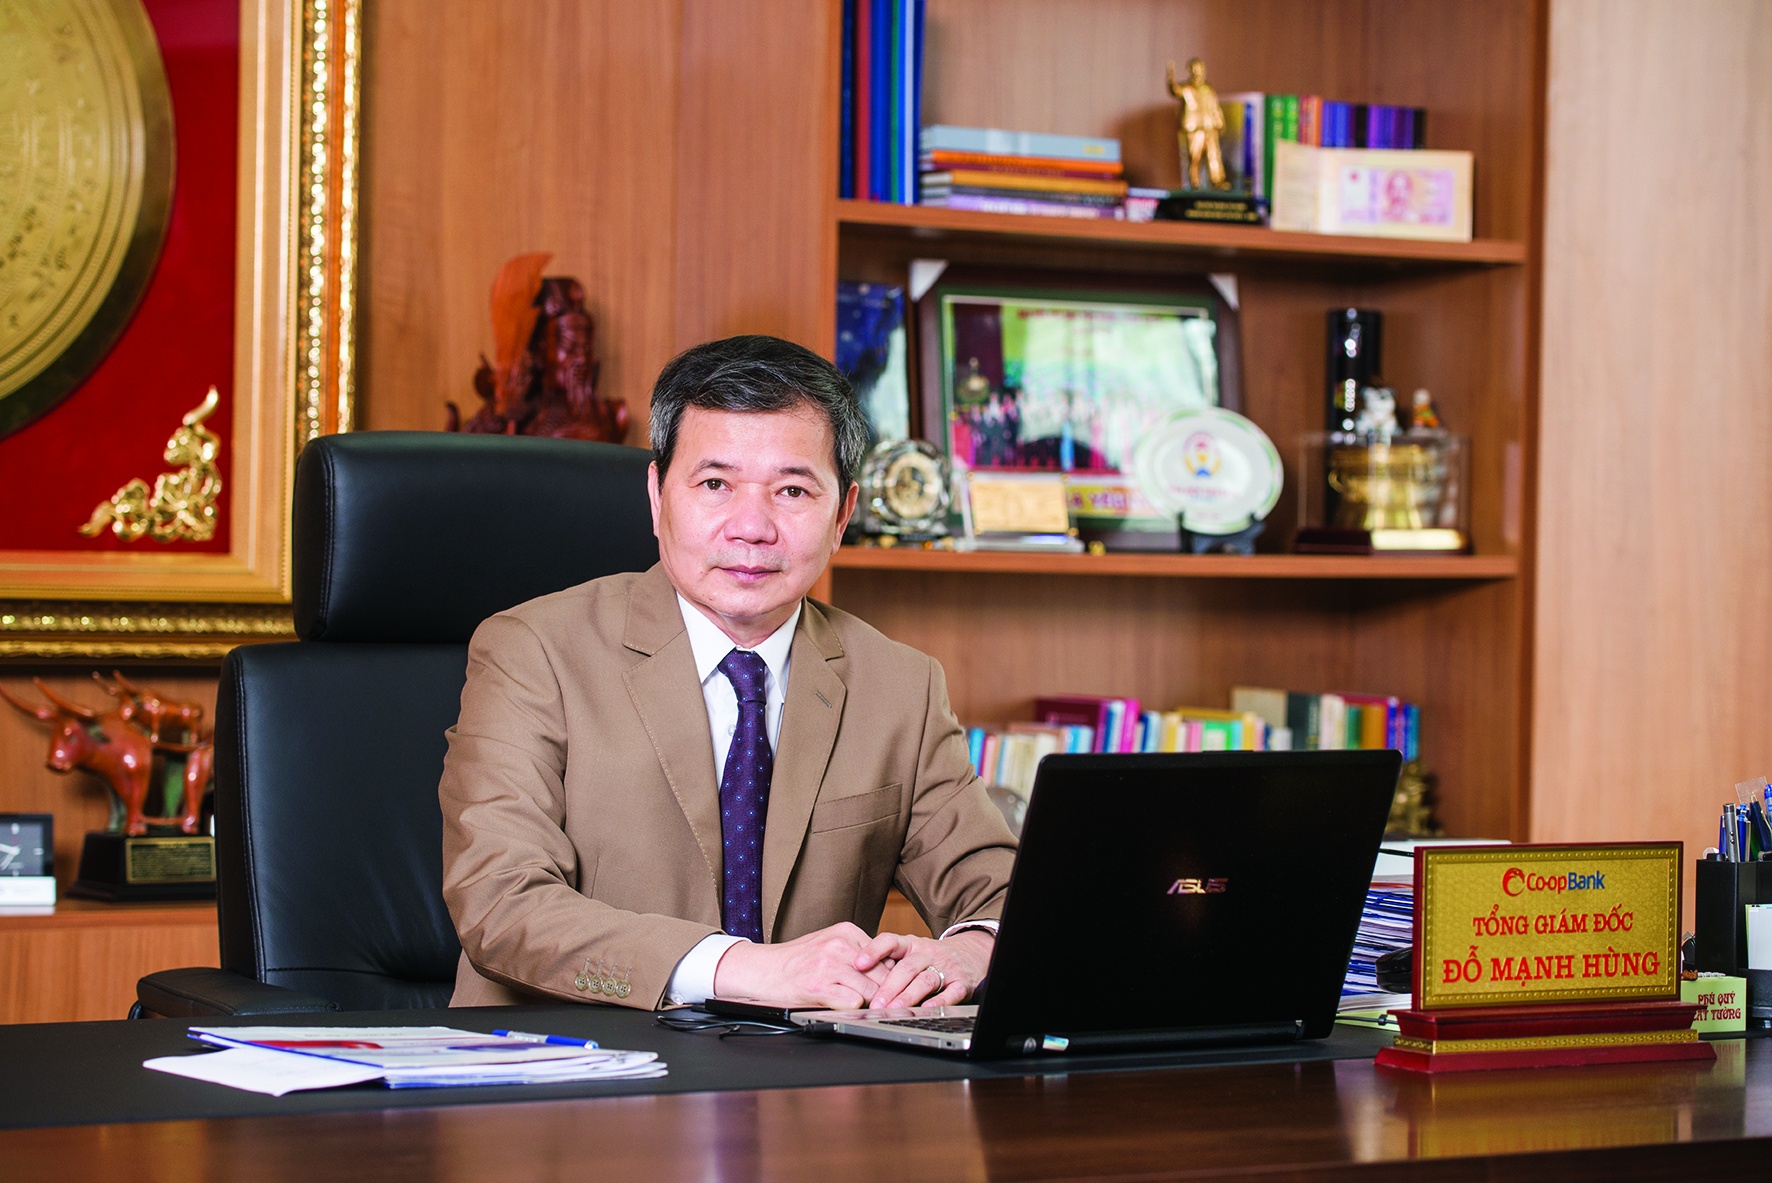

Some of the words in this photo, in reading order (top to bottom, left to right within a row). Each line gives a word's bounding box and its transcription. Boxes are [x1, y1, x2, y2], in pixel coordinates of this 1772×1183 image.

[1166, 878, 1228, 894] ASUS
[1473, 904, 1529, 936] TỔNG
[1534, 908, 1588, 935] GIÁM
[1593, 903, 1634, 932] ĐỐC
[1442, 945, 1482, 983] ĐỖ
[1490, 955, 1574, 987] MẠNH
[1582, 946, 1660, 977] HÙNG
